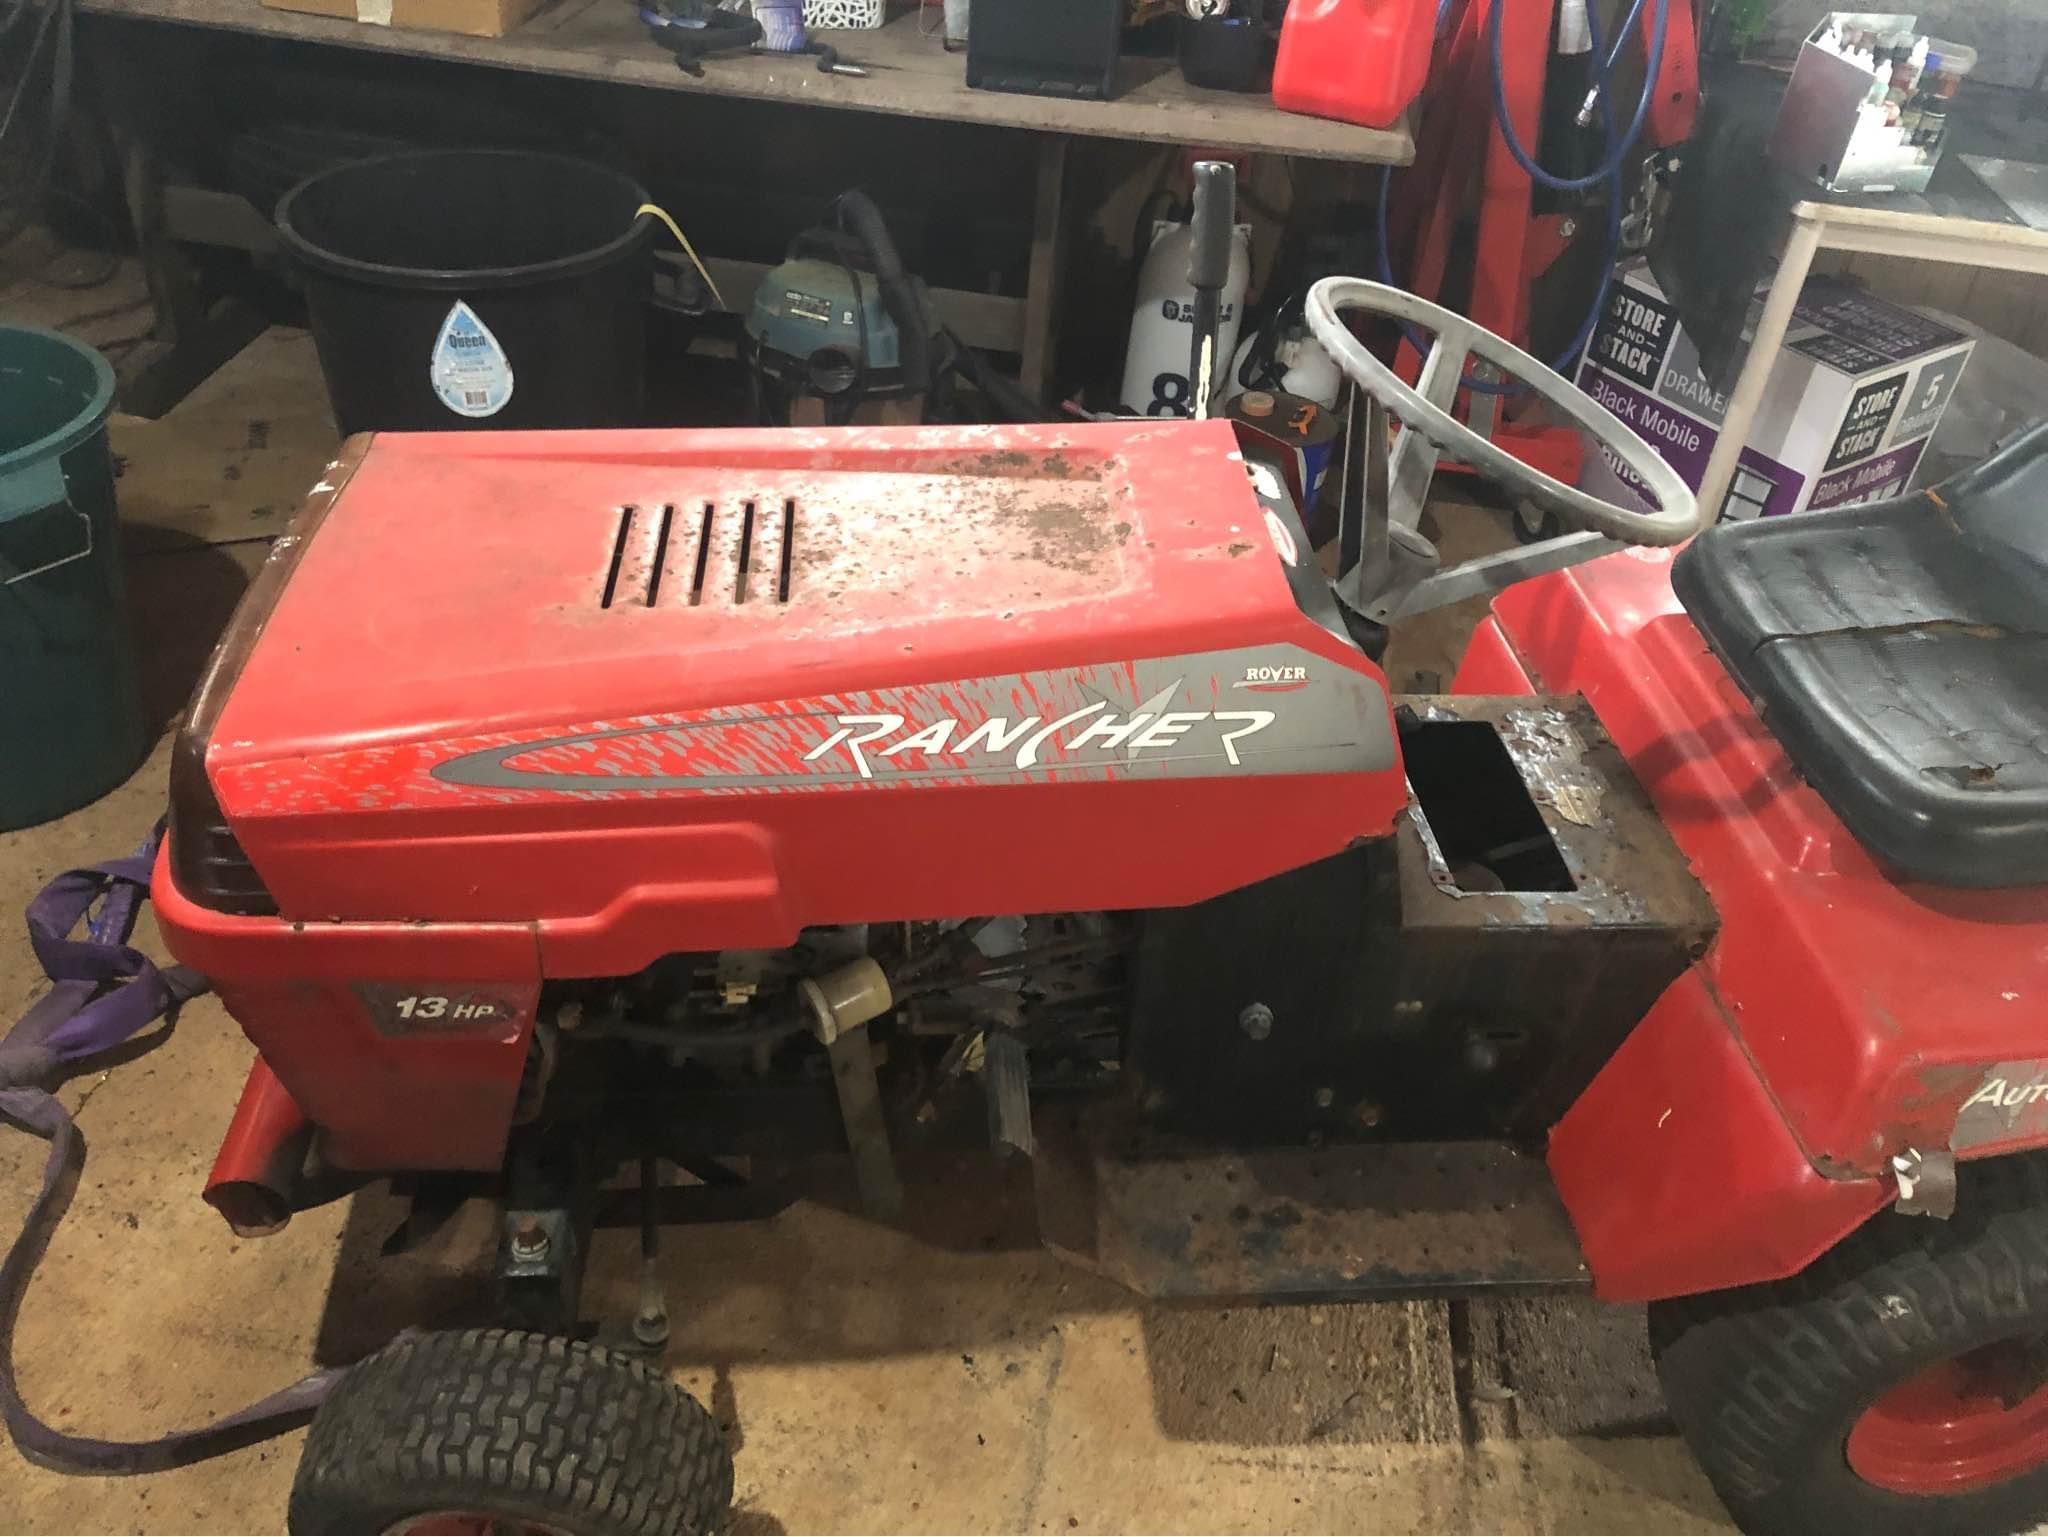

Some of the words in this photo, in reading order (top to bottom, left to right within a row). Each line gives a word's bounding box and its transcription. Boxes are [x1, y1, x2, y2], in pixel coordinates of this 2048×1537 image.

[1612, 295, 1667, 337] STORE
[448, 334, 488, 350] Queen
[1617, 325, 1646, 345] AND
[1601, 334, 1653, 377] STACK
[1853, 386, 1898, 419] STORE
[1921, 373, 1945, 410] 5
[1591, 379, 1638, 420] Black
[1639, 405, 1701, 452] Mobile
[1855, 416, 1878, 431] AND
[1836, 426, 1881, 459] STACK
[1813, 475, 1852, 505] Black
[1852, 458, 1897, 490] Mobile
[1246, 665, 1306, 683] ROVER
[803, 699, 1277, 779] RANCHER
[396, 996, 449, 1019] 13
[453, 1004, 495, 1019] HP
[1958, 1079, 2048, 1113] AUT
